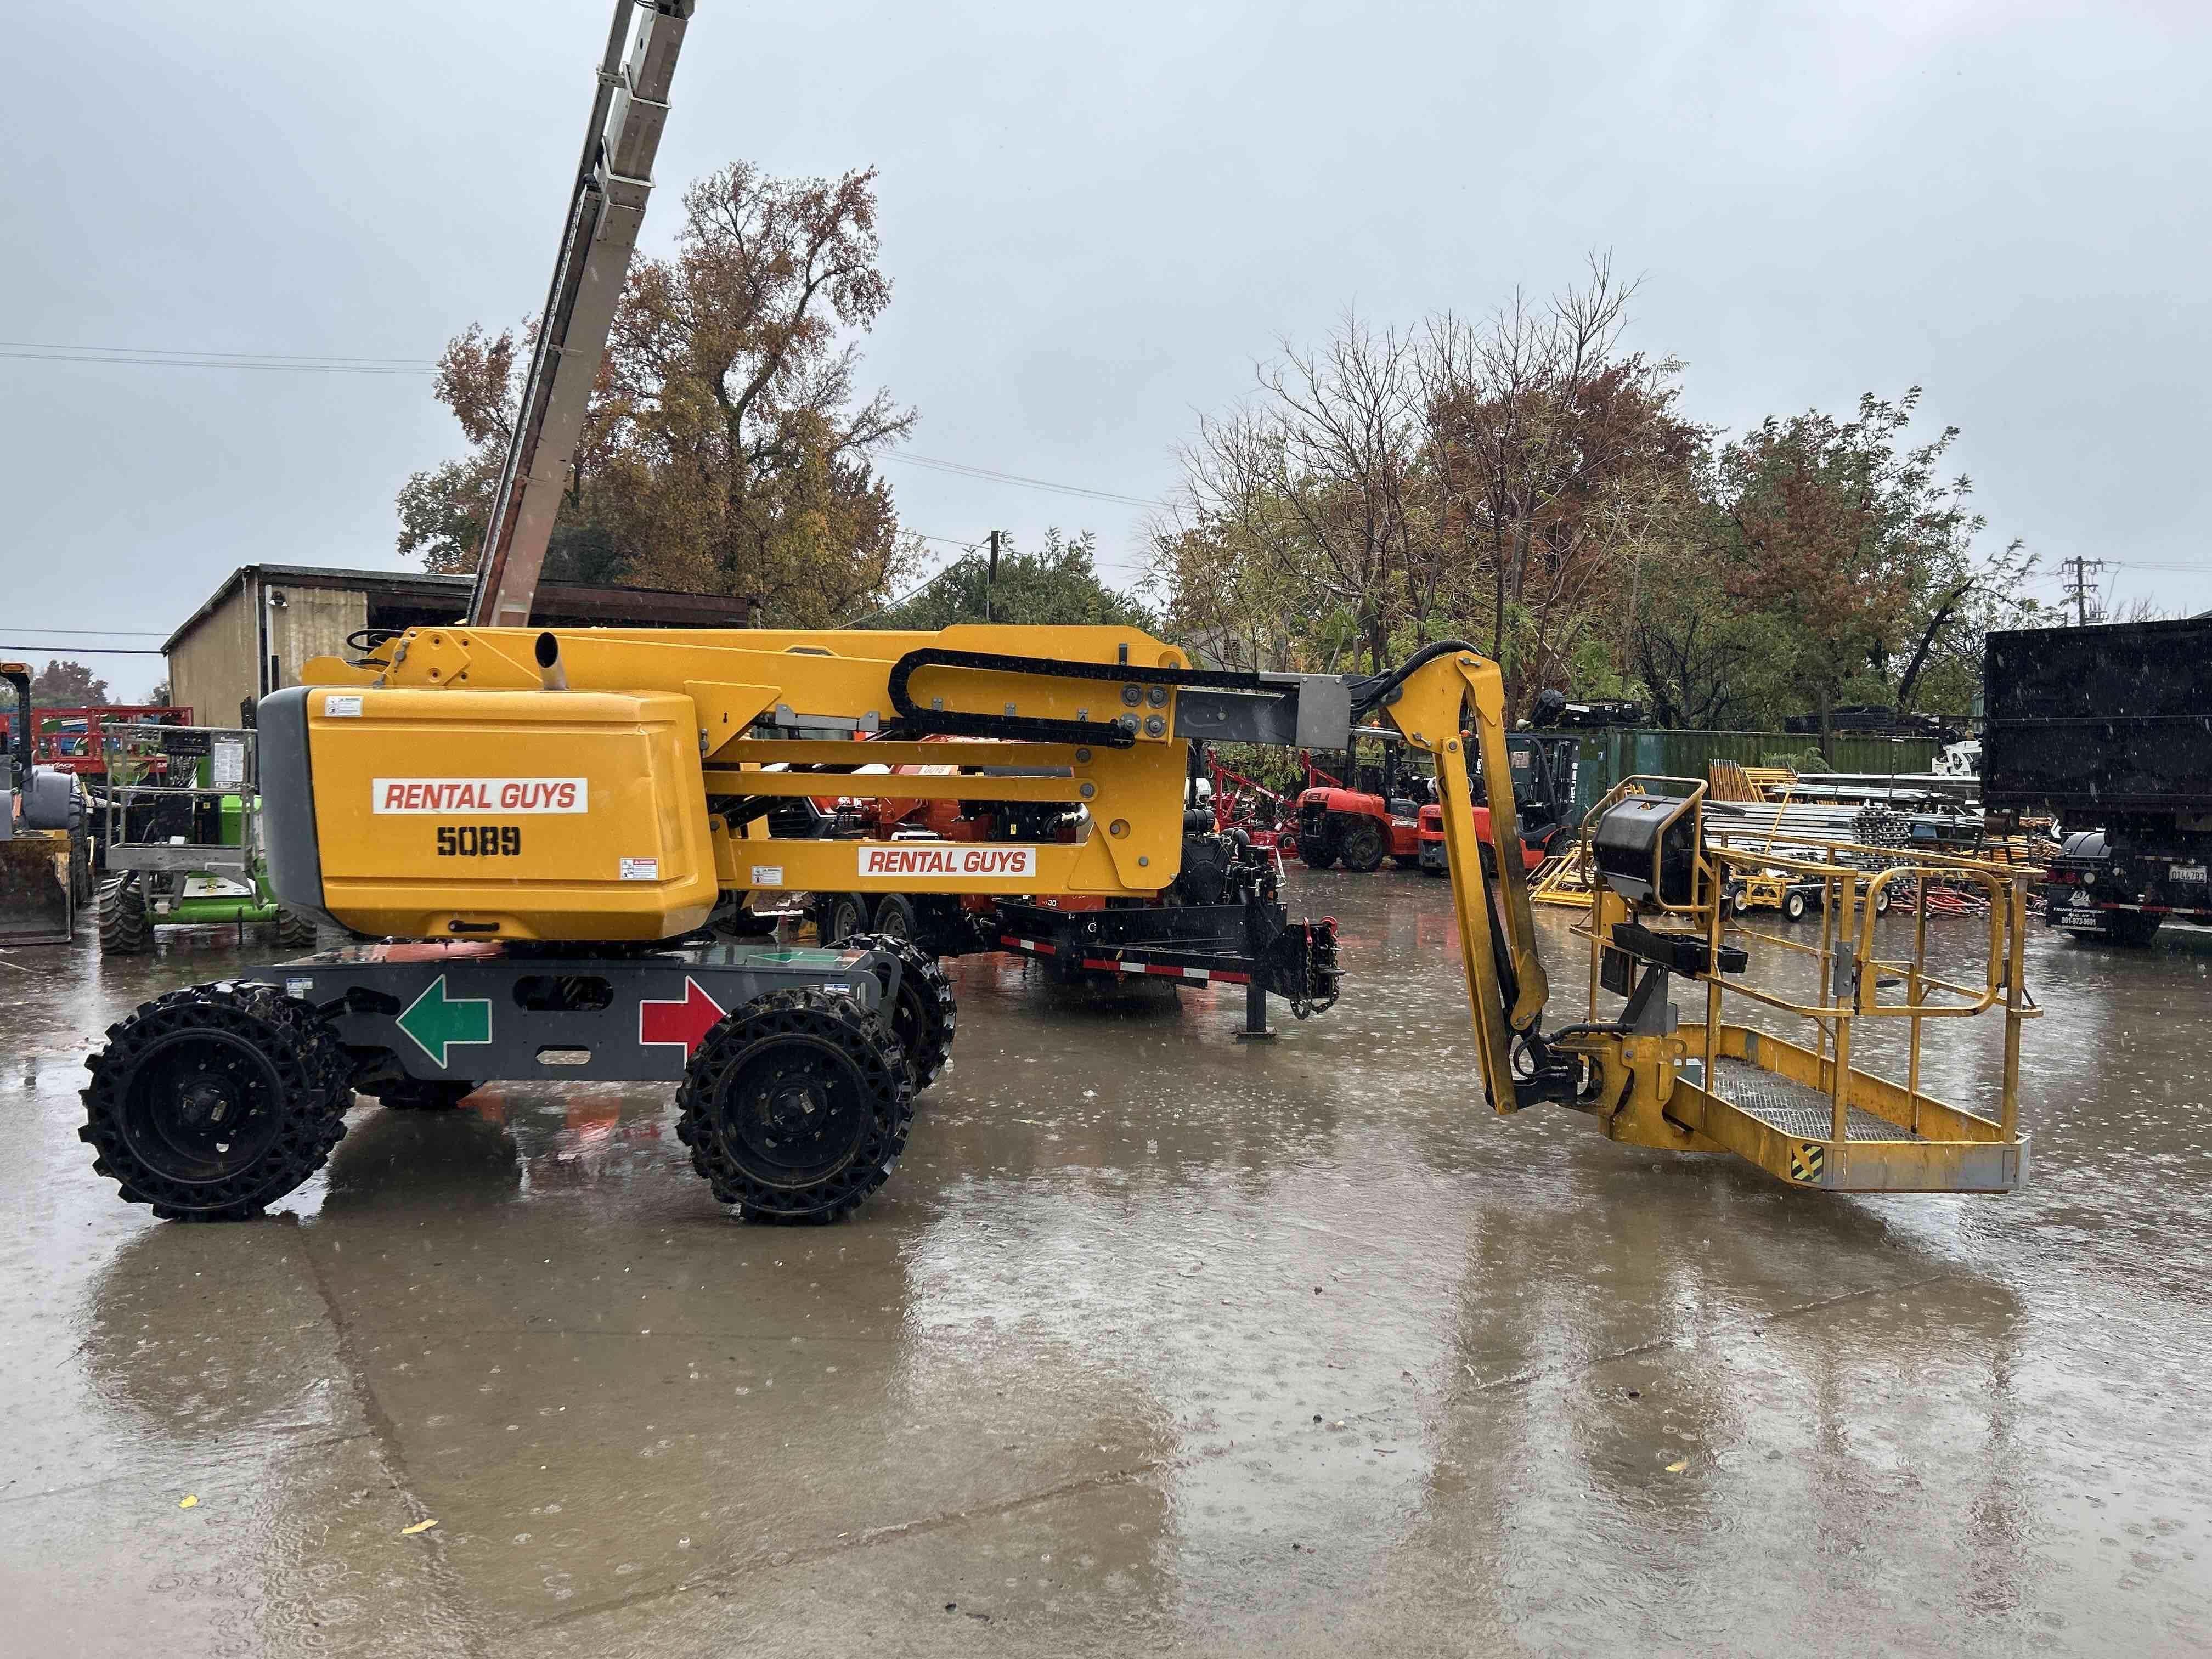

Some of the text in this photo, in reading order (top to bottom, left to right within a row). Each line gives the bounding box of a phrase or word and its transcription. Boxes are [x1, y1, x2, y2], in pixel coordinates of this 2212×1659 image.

[384, 783, 576, 809] RENTAL GUYS
[437, 826, 521, 856] 5089
[868, 851, 1027, 872] RENTAL GUYS
